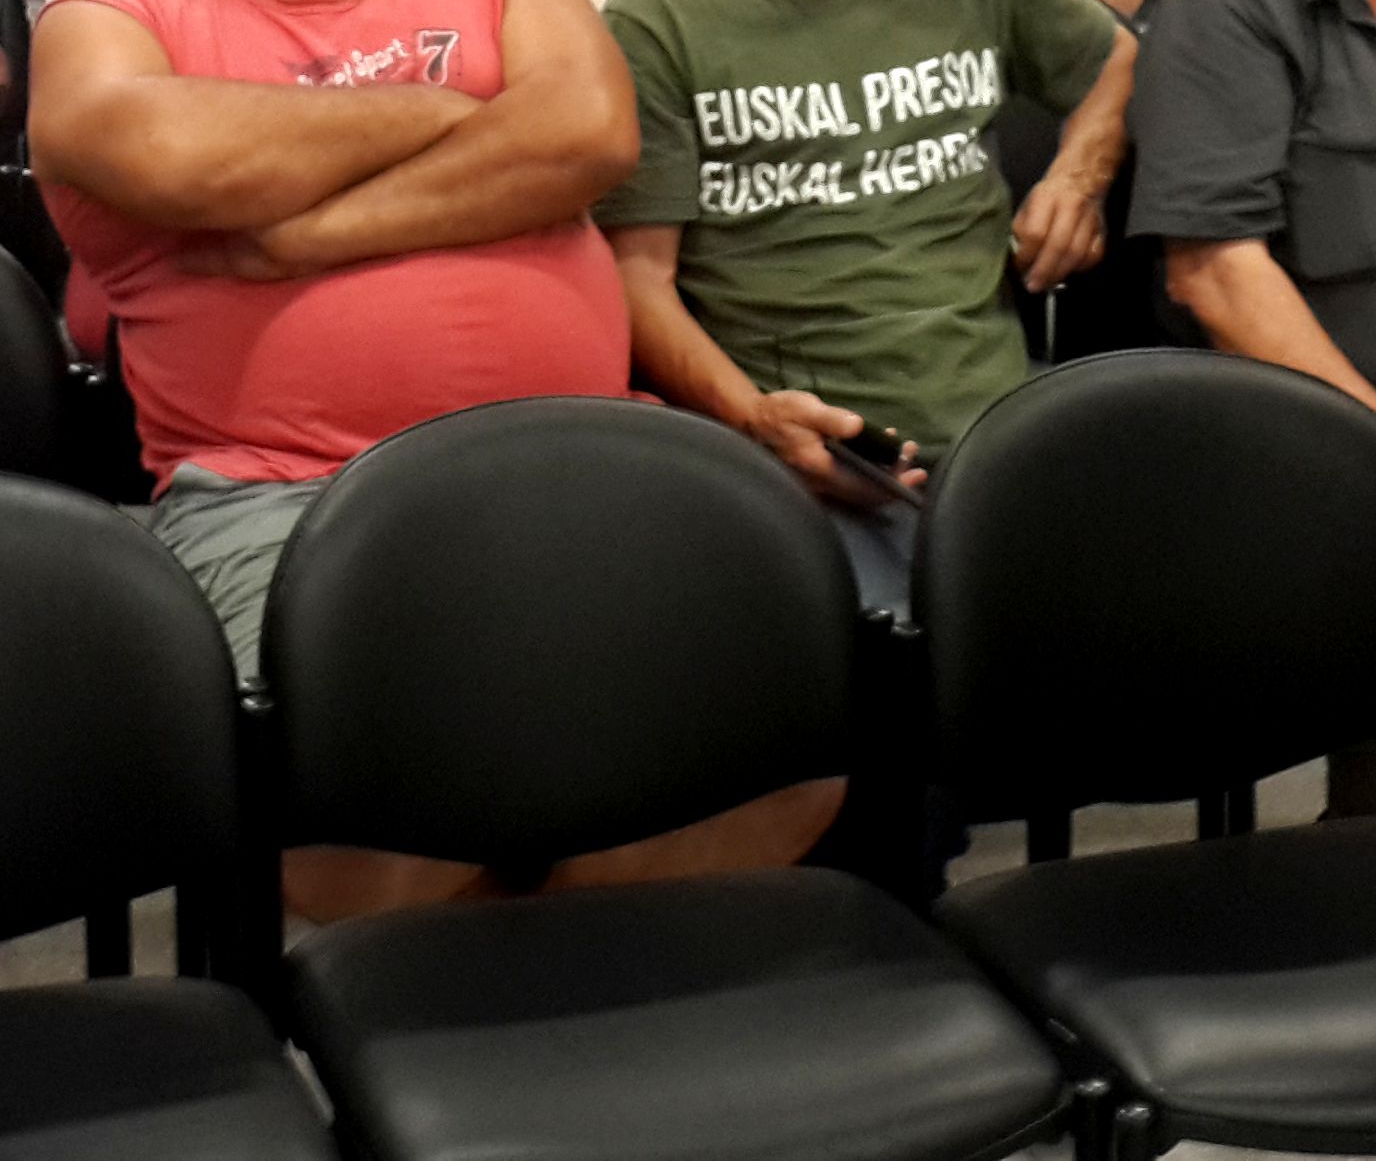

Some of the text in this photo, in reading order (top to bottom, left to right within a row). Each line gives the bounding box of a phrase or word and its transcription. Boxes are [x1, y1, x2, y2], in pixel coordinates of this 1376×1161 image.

[418, 28, 460, 86] 7
[693, 82, 862, 147] EUSKAL
[699, 160, 857, 215] EUSKAL
